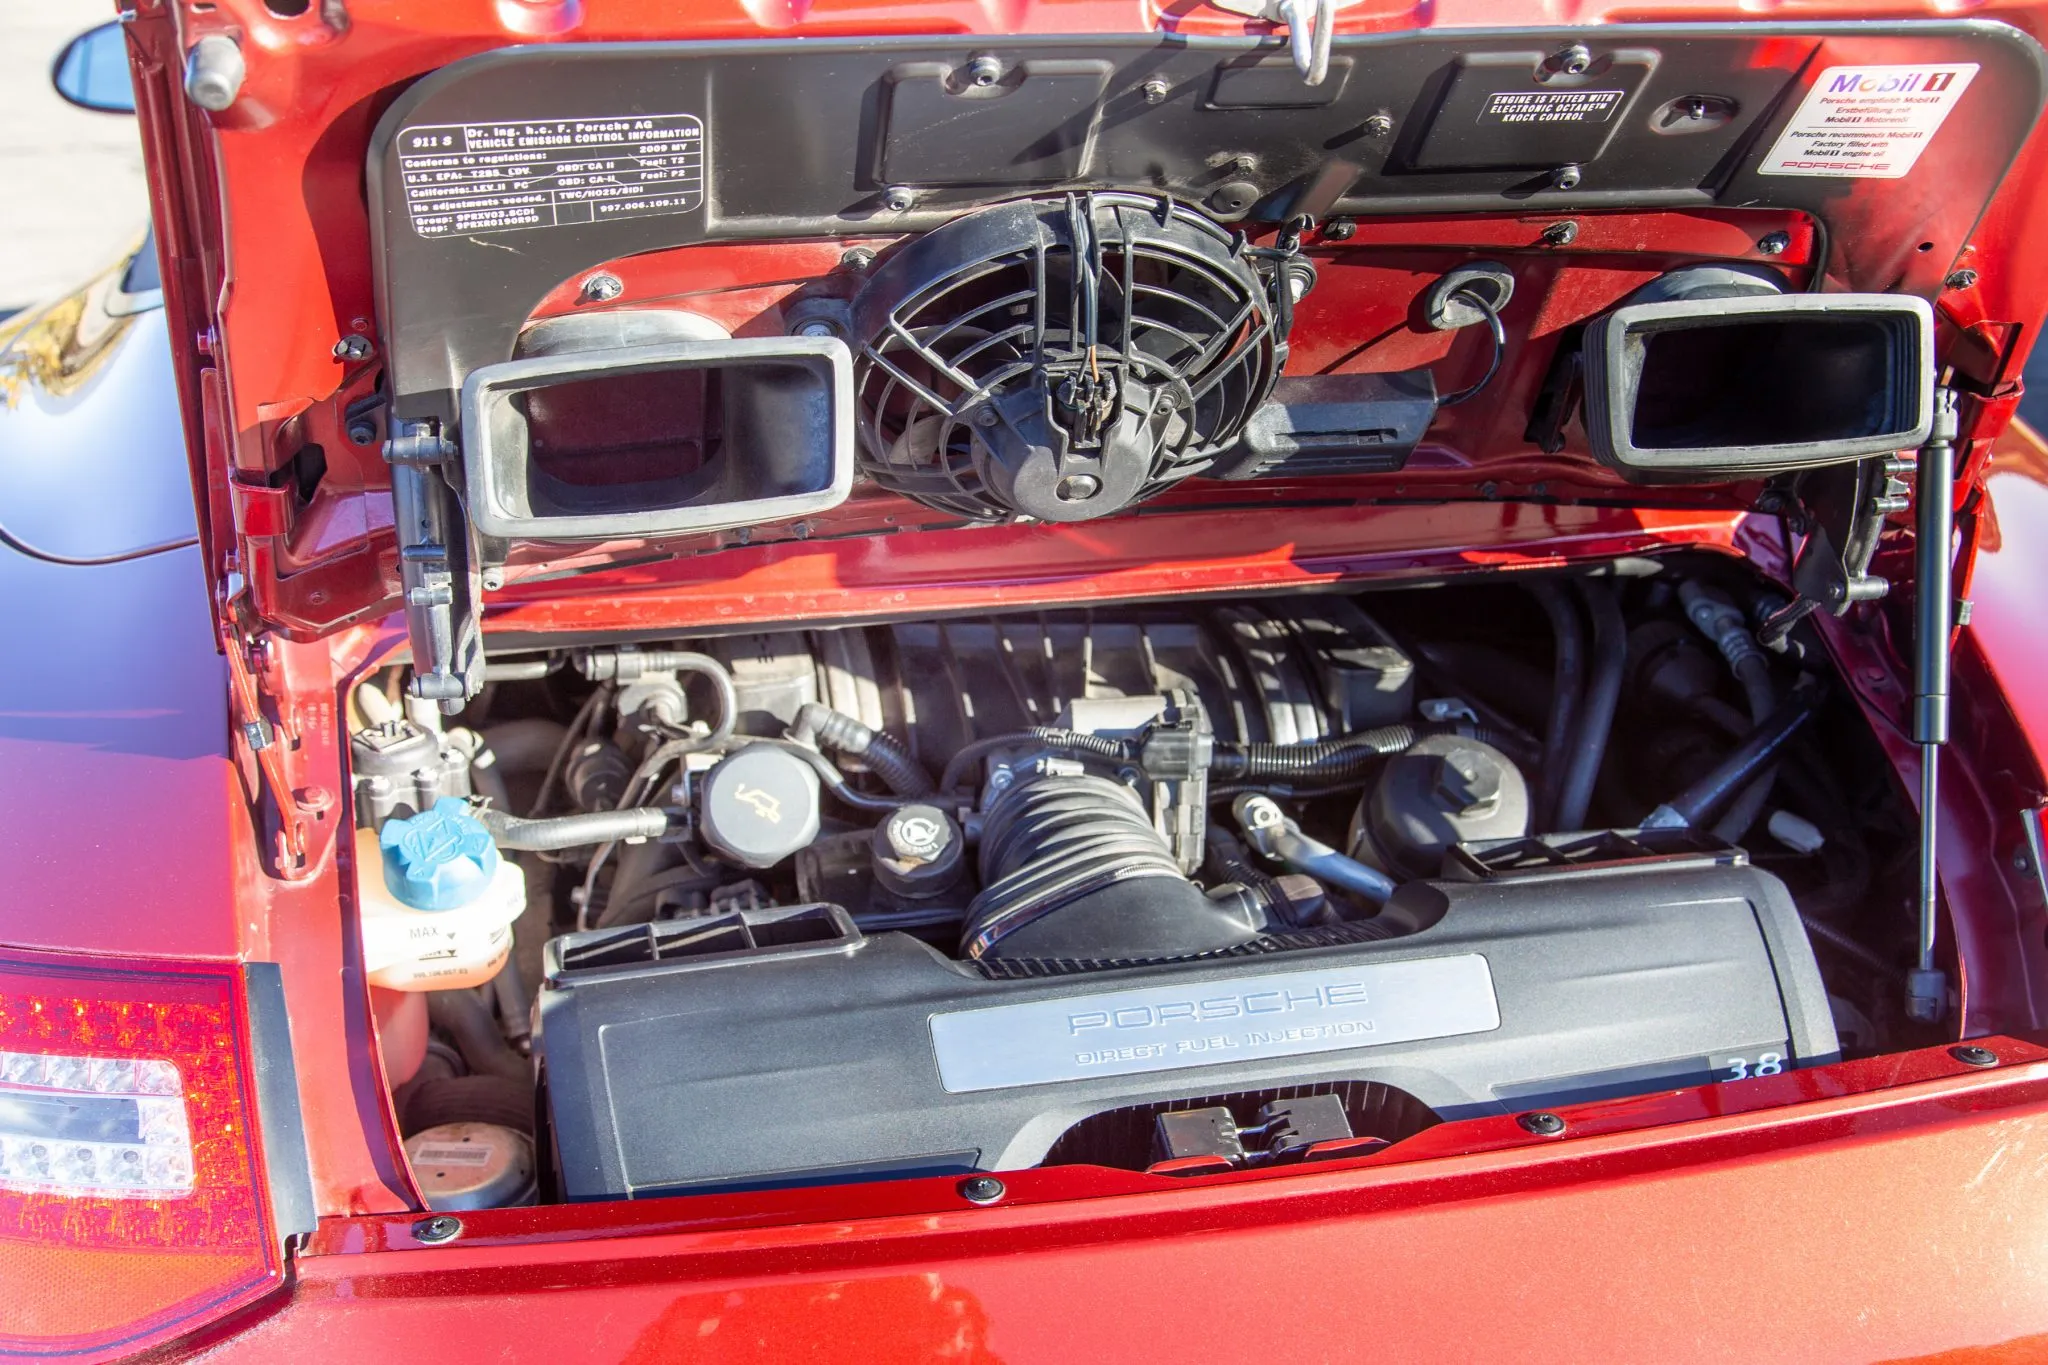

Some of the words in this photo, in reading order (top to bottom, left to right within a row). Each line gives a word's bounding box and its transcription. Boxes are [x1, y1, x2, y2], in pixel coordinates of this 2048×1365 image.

[1828, 73, 1922, 92] Mobil
[1494, 95, 1533, 104] ENGINE
[1534, 95, 1547, 104] IS
[1549, 94, 1586, 104] FITTED
[1588, 93, 1615, 102] WITH
[1490, 104, 1553, 114] ELECTRONIC
[1502, 113, 1537, 122] KNOCK
[1539, 112, 1584, 121] CONTROL
[468, 128, 489, 138] Dr.
[494, 127, 520, 138] Ing.
[525, 126, 552, 135] h.c.
[557, 124, 571, 133] F.
[576, 121, 630, 132] Porsche
[635, 120, 653, 130] AG
[412, 137, 438, 147] 911
[442, 136, 452, 146] S
[468, 138, 515, 149] VEHICLE
[518, 135, 571, 146] EMISSION
[575, 132, 624, 143] CONTROL
[628, 128, 699, 140] INFORMATION
[1811, 140, 1845, 148] Factory
[639, 144, 668, 153] 2009
[671, 143, 687, 151] MY
[405, 157, 459, 168] Conforms
[462, 155, 475, 164] to
[479, 152, 547, 163] regulations:
[1781, 161, 1891, 170] PORSCHE
[408, 174, 433, 183] U.S.
[436, 171, 463, 181] EPA:
[556, 163, 584, 173] OBD:
[588, 162, 603, 170] CA
[606, 161, 615, 169] II
[640, 158, 667, 167] Fuel:
[410, 186, 470, 198] California:
[514, 181, 530, 190] PC
[558, 177, 585, 186] OBD:
[589, 175, 604, 184] CA
[607, 174, 615, 183] II
[640, 171, 667, 180] Fuel:
[671, 169, 685, 178] P2
[413, 204, 429, 212] No
[432, 199, 499, 213] adjustments
[500, 194, 546, 205] needed.
[416, 216, 453, 226] Group:
[417, 224, 449, 234] Evap:
[410, 926, 439, 940] MAX
[1067, 981, 1368, 1037] PORSCHE
[1075, 1043, 1167, 1066] DIRECT
[1175, 1035, 1239, 1054] FUEL
[1245, 1020, 1376, 1046] INJECTION
[1722, 1052, 1782, 1082] 3.8
